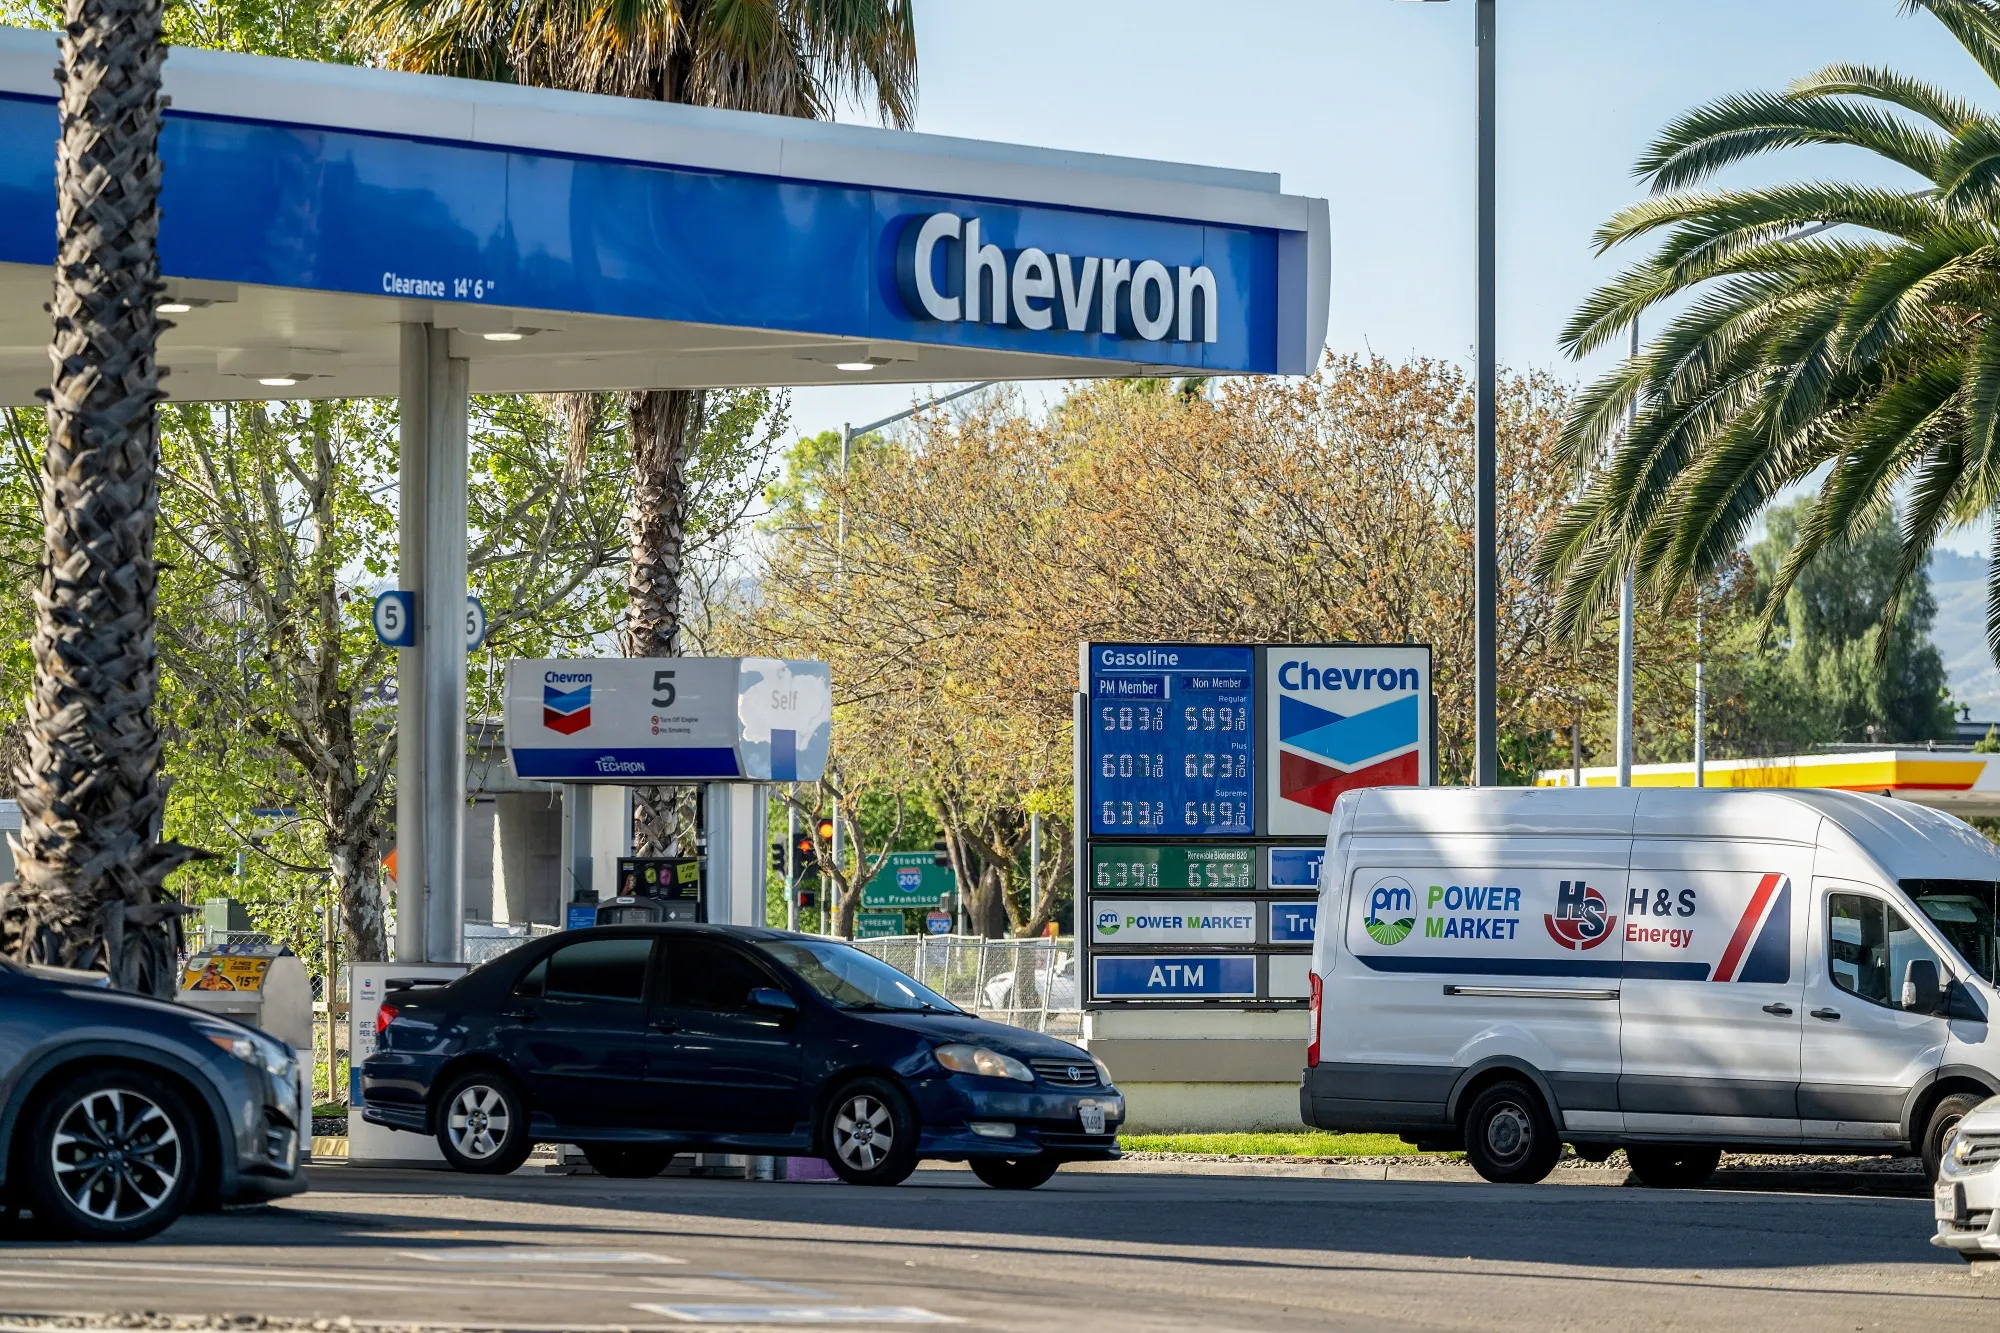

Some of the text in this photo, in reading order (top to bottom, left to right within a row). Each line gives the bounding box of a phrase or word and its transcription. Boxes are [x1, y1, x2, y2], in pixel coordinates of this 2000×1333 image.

[383, 272, 445, 297] Clearance
[914, 212, 1217, 343] Chevron
[385, 605, 398, 630] 5
[466, 611, 476, 635] 6
[1102, 650, 1178, 666] Gasoline
[544, 671, 592, 683] Chevron
[1193, 678, 1241, 688] Non Member
[1278, 661, 1419, 691] Chevron
[651, 670, 676, 708] 5
[1100, 680, 1158, 694] PM Member
[771, 690, 798, 710] Self
[893, 856, 934, 865] Stockto
[1187, 851, 1247, 859] Renewable Biodiesel B20
[900, 875, 920, 885] 205
[866, 895, 938, 904] San Francisco
[1427, 886, 1521, 911] POWER
[864, 919, 896, 927] FREEWAY
[1126, 916, 1252, 929] POWER MARKET
[1286, 914, 1316, 932] Tru
[1425, 917, 1519, 939] MARKET
[1625, 924, 1694, 948] Energy
[1147, 965, 1204, 987] ATM
